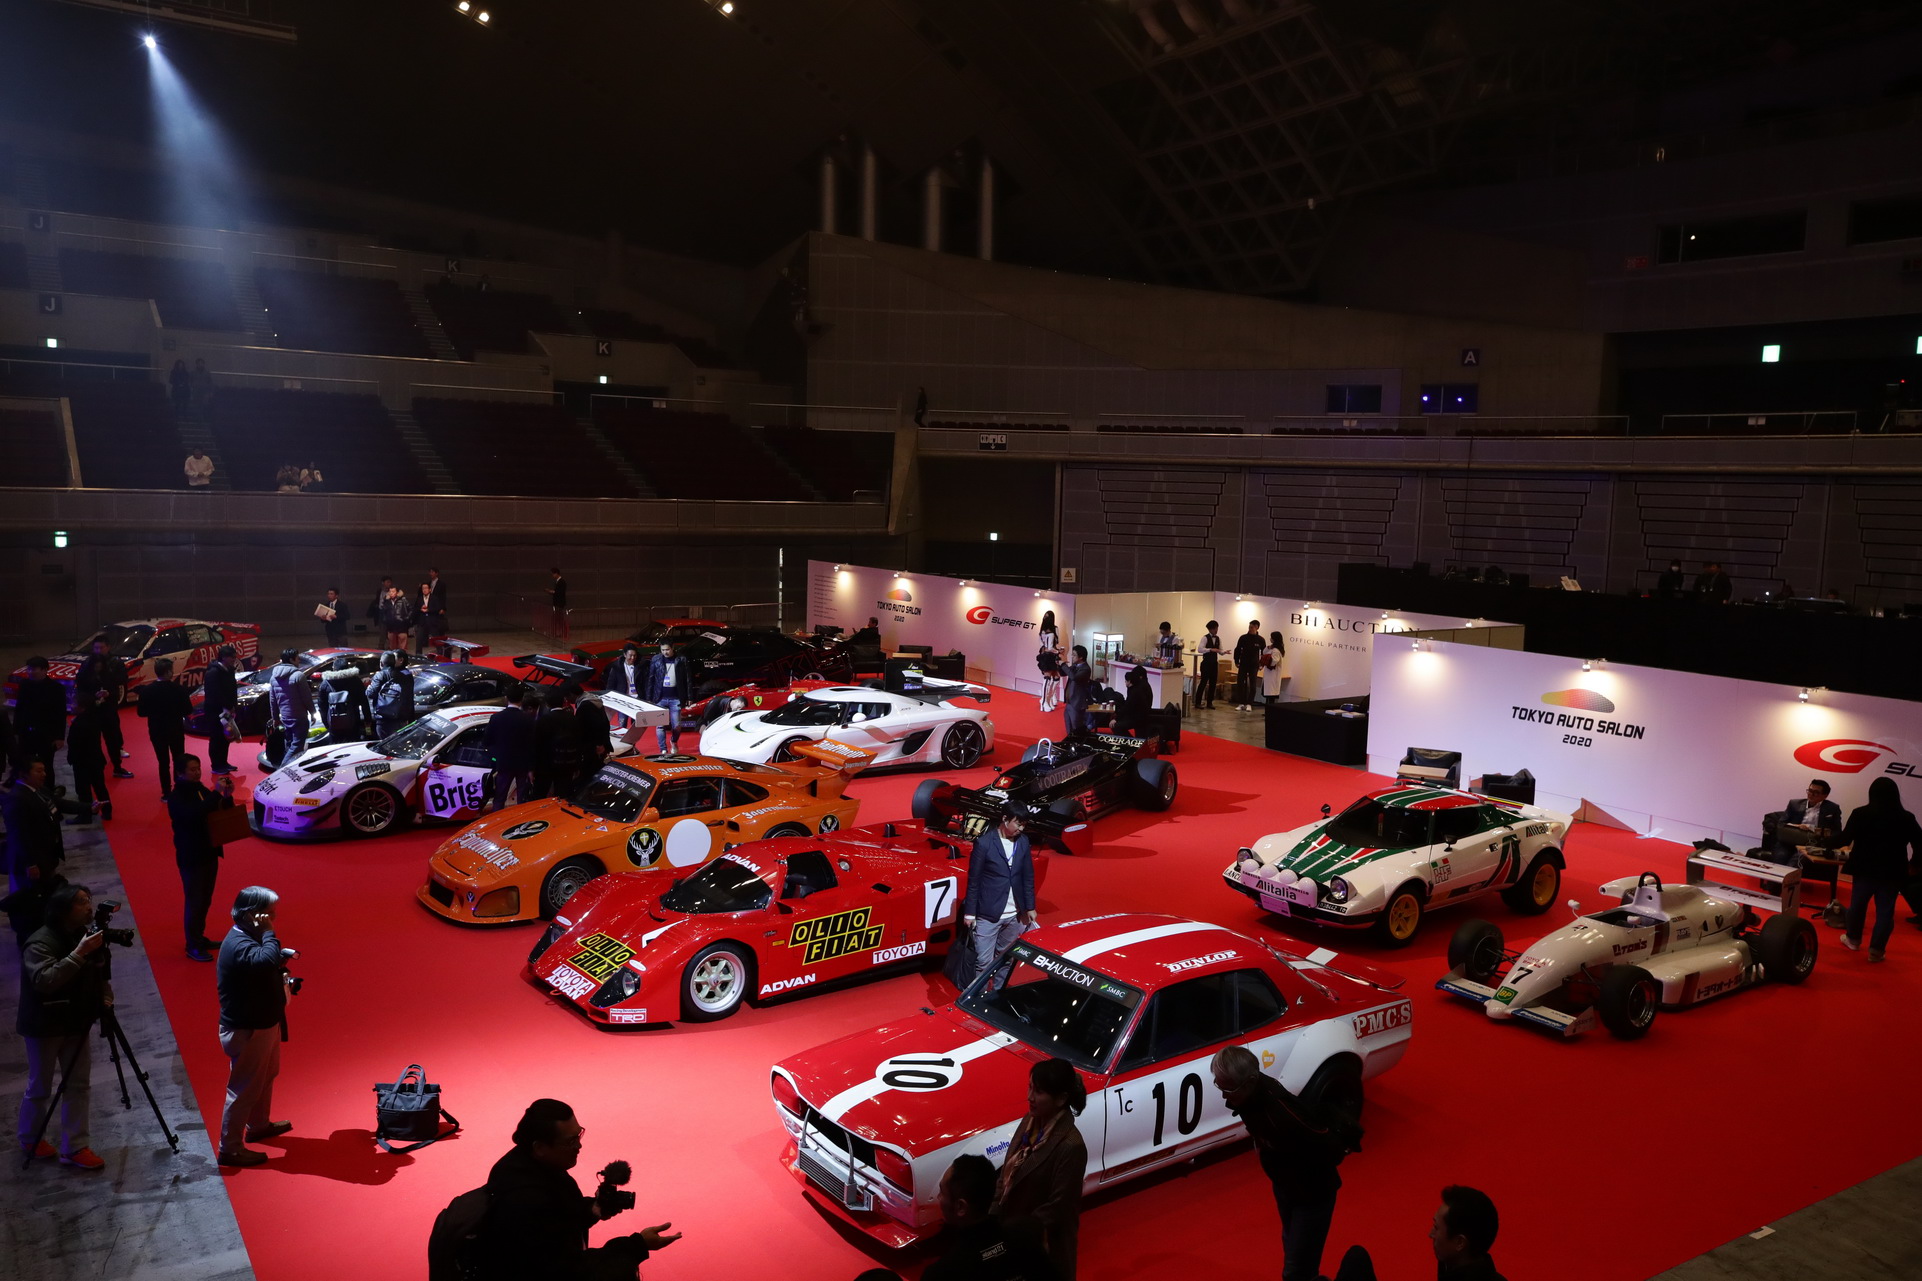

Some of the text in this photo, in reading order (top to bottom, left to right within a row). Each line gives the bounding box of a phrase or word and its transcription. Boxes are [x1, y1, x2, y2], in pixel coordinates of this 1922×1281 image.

[34, 216, 43, 228] J
[449, 260, 458, 272] K
[45, 298, 55, 311] J
[599, 342, 609, 354] K
[1464, 351, 1476, 364] A
[877, 601, 922, 615] TOKYO AUTO SALON
[991, 616, 1036, 630] SUPER GT
[1290, 613, 1317, 627] BH
[1289, 636, 1367, 653] OFFICIAL PARTNER
[1512, 706, 1646, 740] TOKYO AUTO SALON
[1098, 734, 1145, 748] COURAGE
[1562, 734, 1593, 747] 2020
[720, 853, 761, 873] ADVAN
[1256, 880, 1297, 900] Alitalia
[930, 879, 951, 925] 7
[794, 912, 866, 942] OLIO
[586, 936, 631, 962] OLIO
[810, 929, 880, 961] FIAT
[874, 943, 924, 963] TOYOTA
[1168, 950, 1238, 974] DUNLOP
[556, 965, 593, 994] TOYOTA
[760, 972, 816, 995] ADVAN
[1511, 967, 1533, 985] 7
[545, 974, 586, 1000] ADVAN
[1106, 985, 1126, 998] SMBC
[611, 1014, 645, 1023] TRD
[882, 1057, 955, 1089] 10
[1114, 1087, 1133, 1116] Tc
[1152, 1072, 1203, 1146] 10
[986, 1141, 1010, 1156] Minolta
